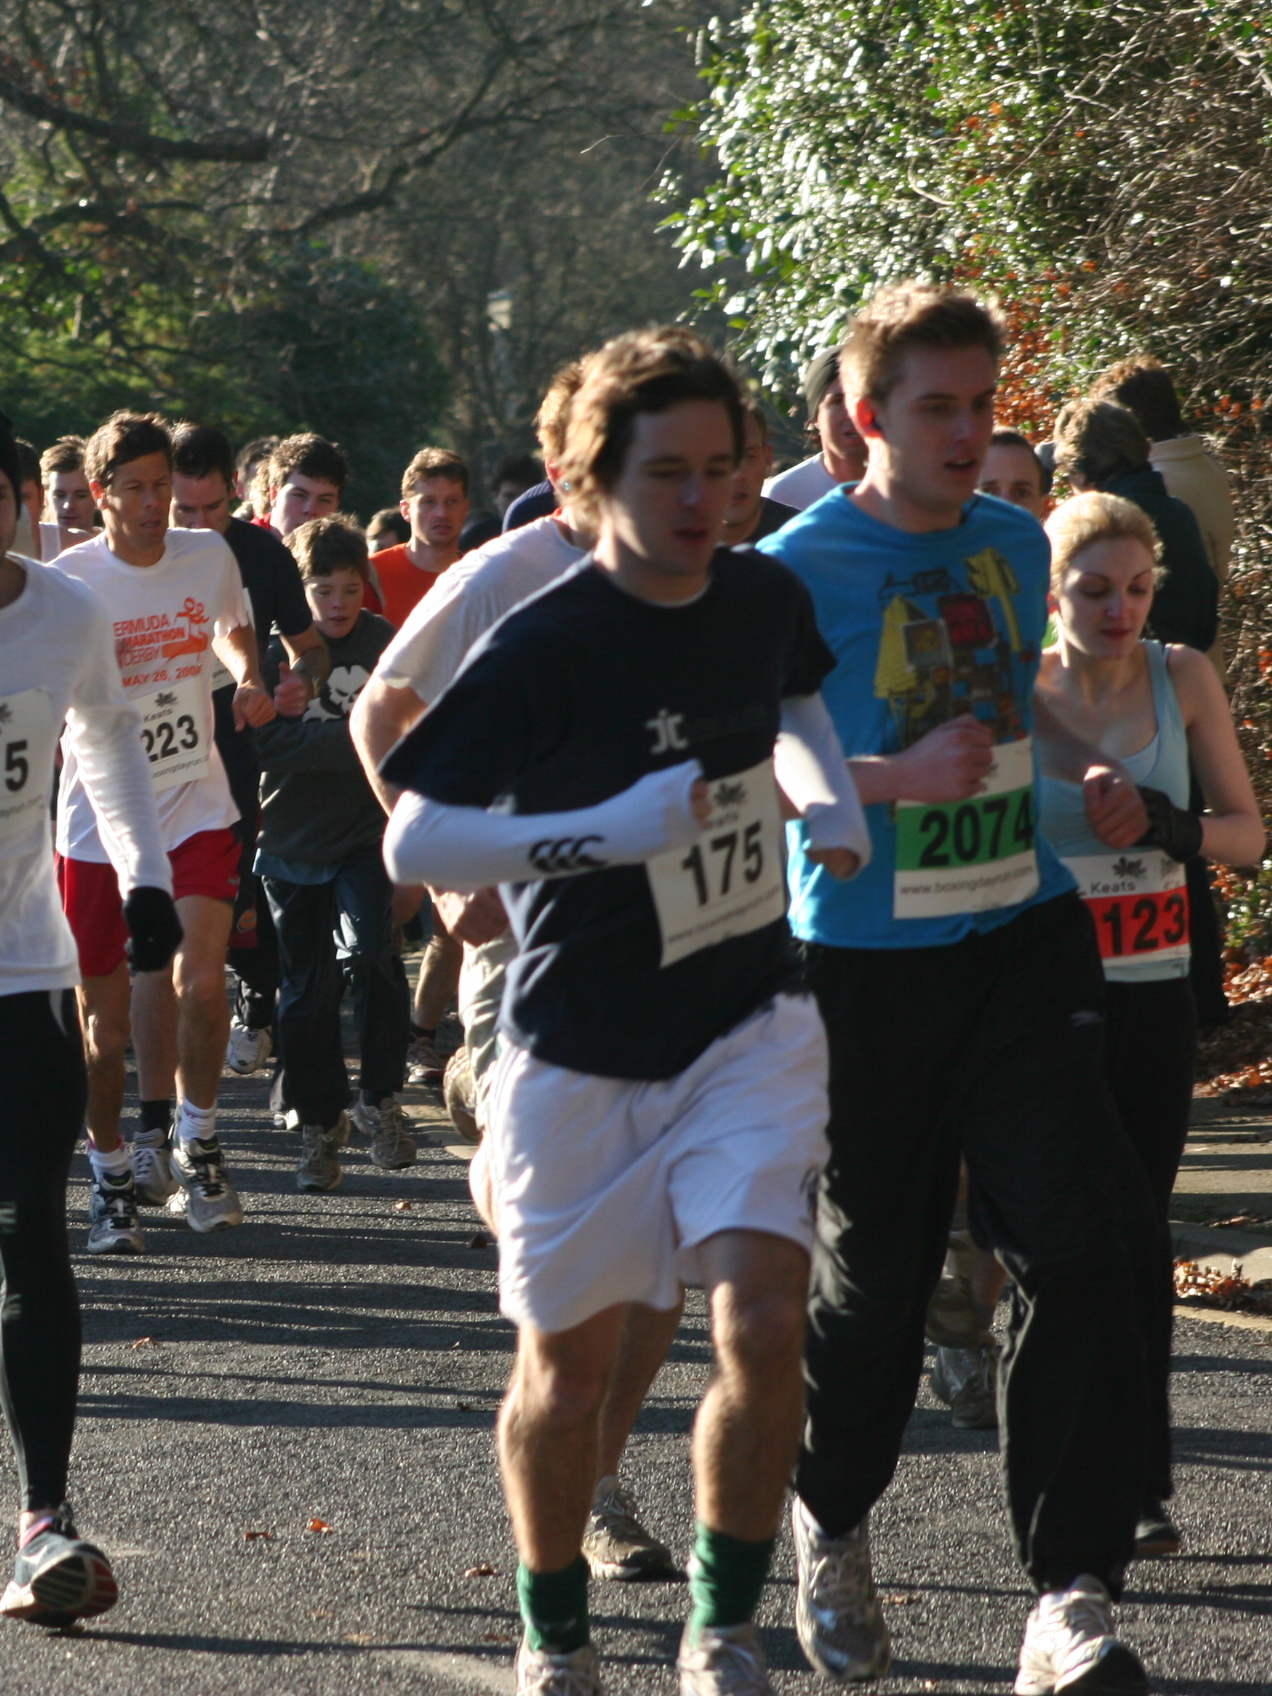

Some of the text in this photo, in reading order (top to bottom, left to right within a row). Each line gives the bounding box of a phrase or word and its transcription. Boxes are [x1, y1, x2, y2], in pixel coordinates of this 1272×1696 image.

[113, 613, 169, 637] ERMUDA
[122, 672, 148, 688] MAY
[140, 714, 199, 763] 223
[919, 790, 1035, 868] 2074
[682, 820, 764, 907] 175
[1090, 880, 1137, 895] Keats
